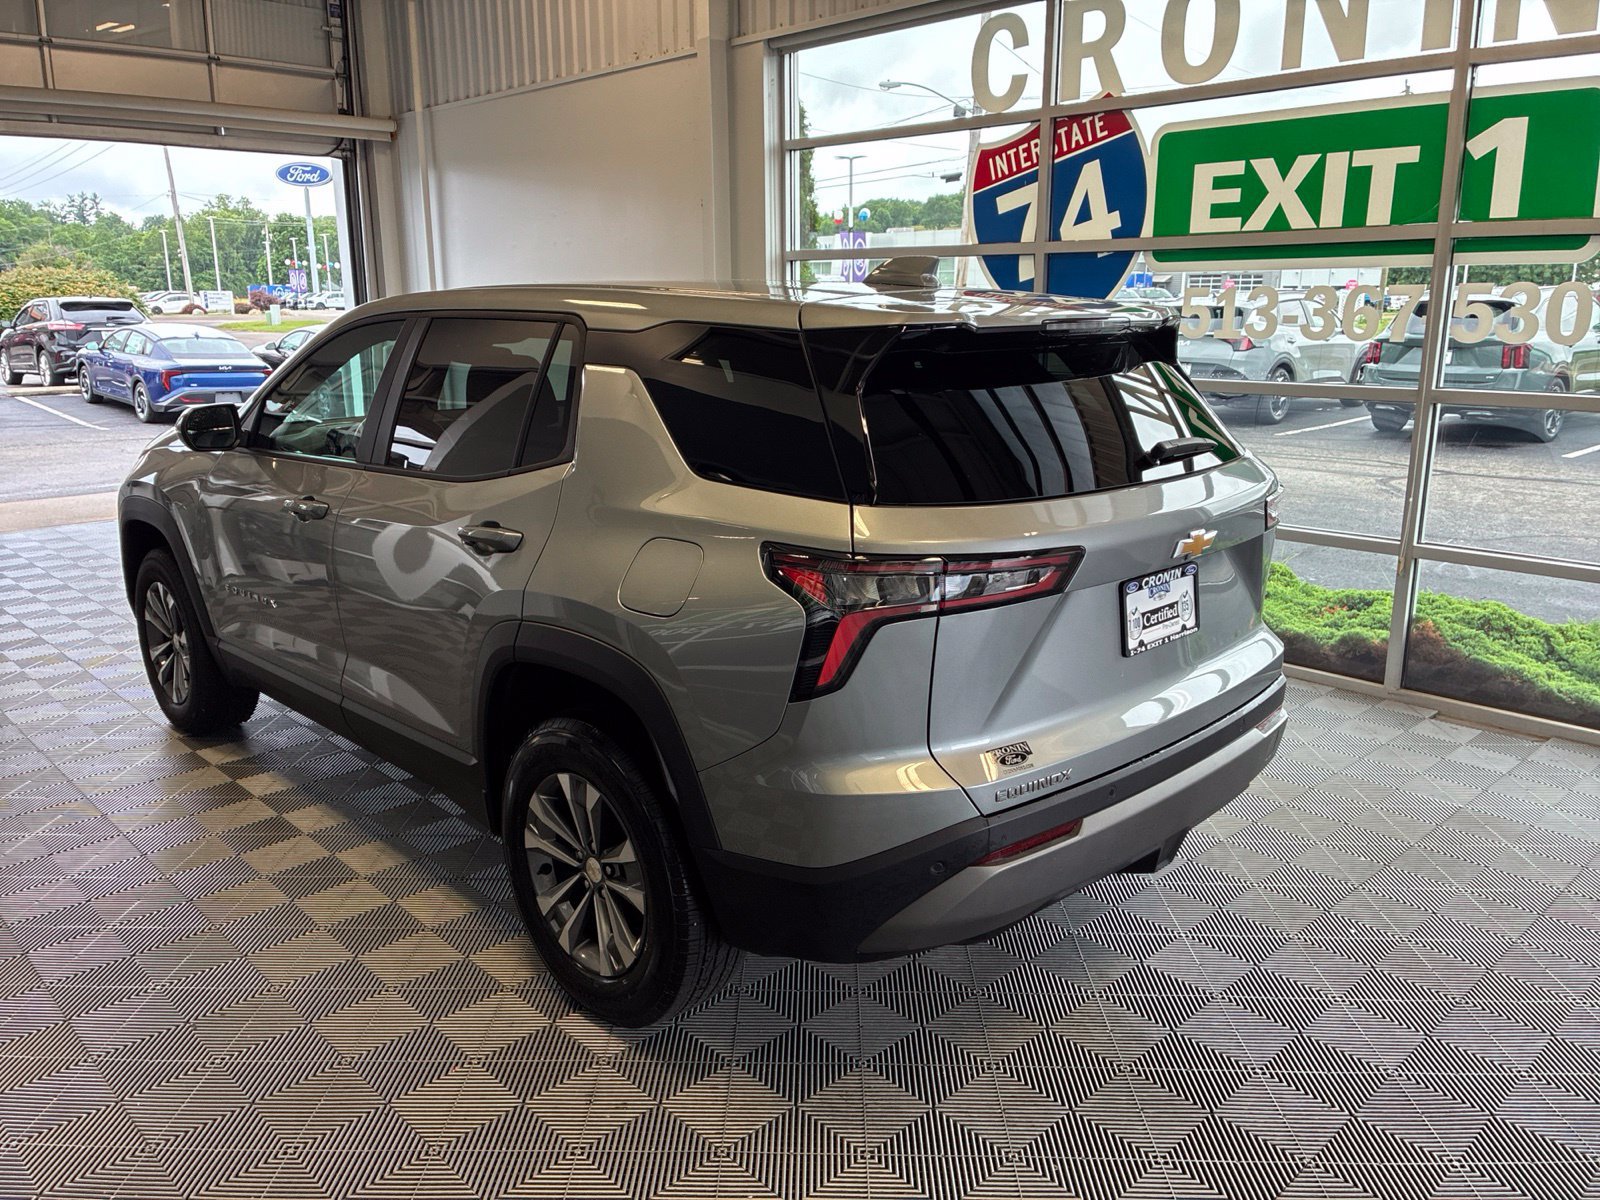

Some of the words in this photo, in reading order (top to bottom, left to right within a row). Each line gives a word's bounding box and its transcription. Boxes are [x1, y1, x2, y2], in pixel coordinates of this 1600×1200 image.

[989, 112, 1109, 181] INTERTATE
[287, 165, 321, 182] Ford
[1190, 146, 1421, 234] EXIT
[1466, 116, 1529, 218] 1
[996, 159, 1122, 282] 74
[1141, 568, 1182, 589] CRONIN
[1143, 604, 1178, 626] Certified
[1130, 645, 1146, 656] I-74
[1147, 639, 1163, 650] EXIT
[1170, 627, 1198, 642] Harrison
[1004, 754, 1023, 765] Ford
[995, 768, 1072, 802] EQUINOX
